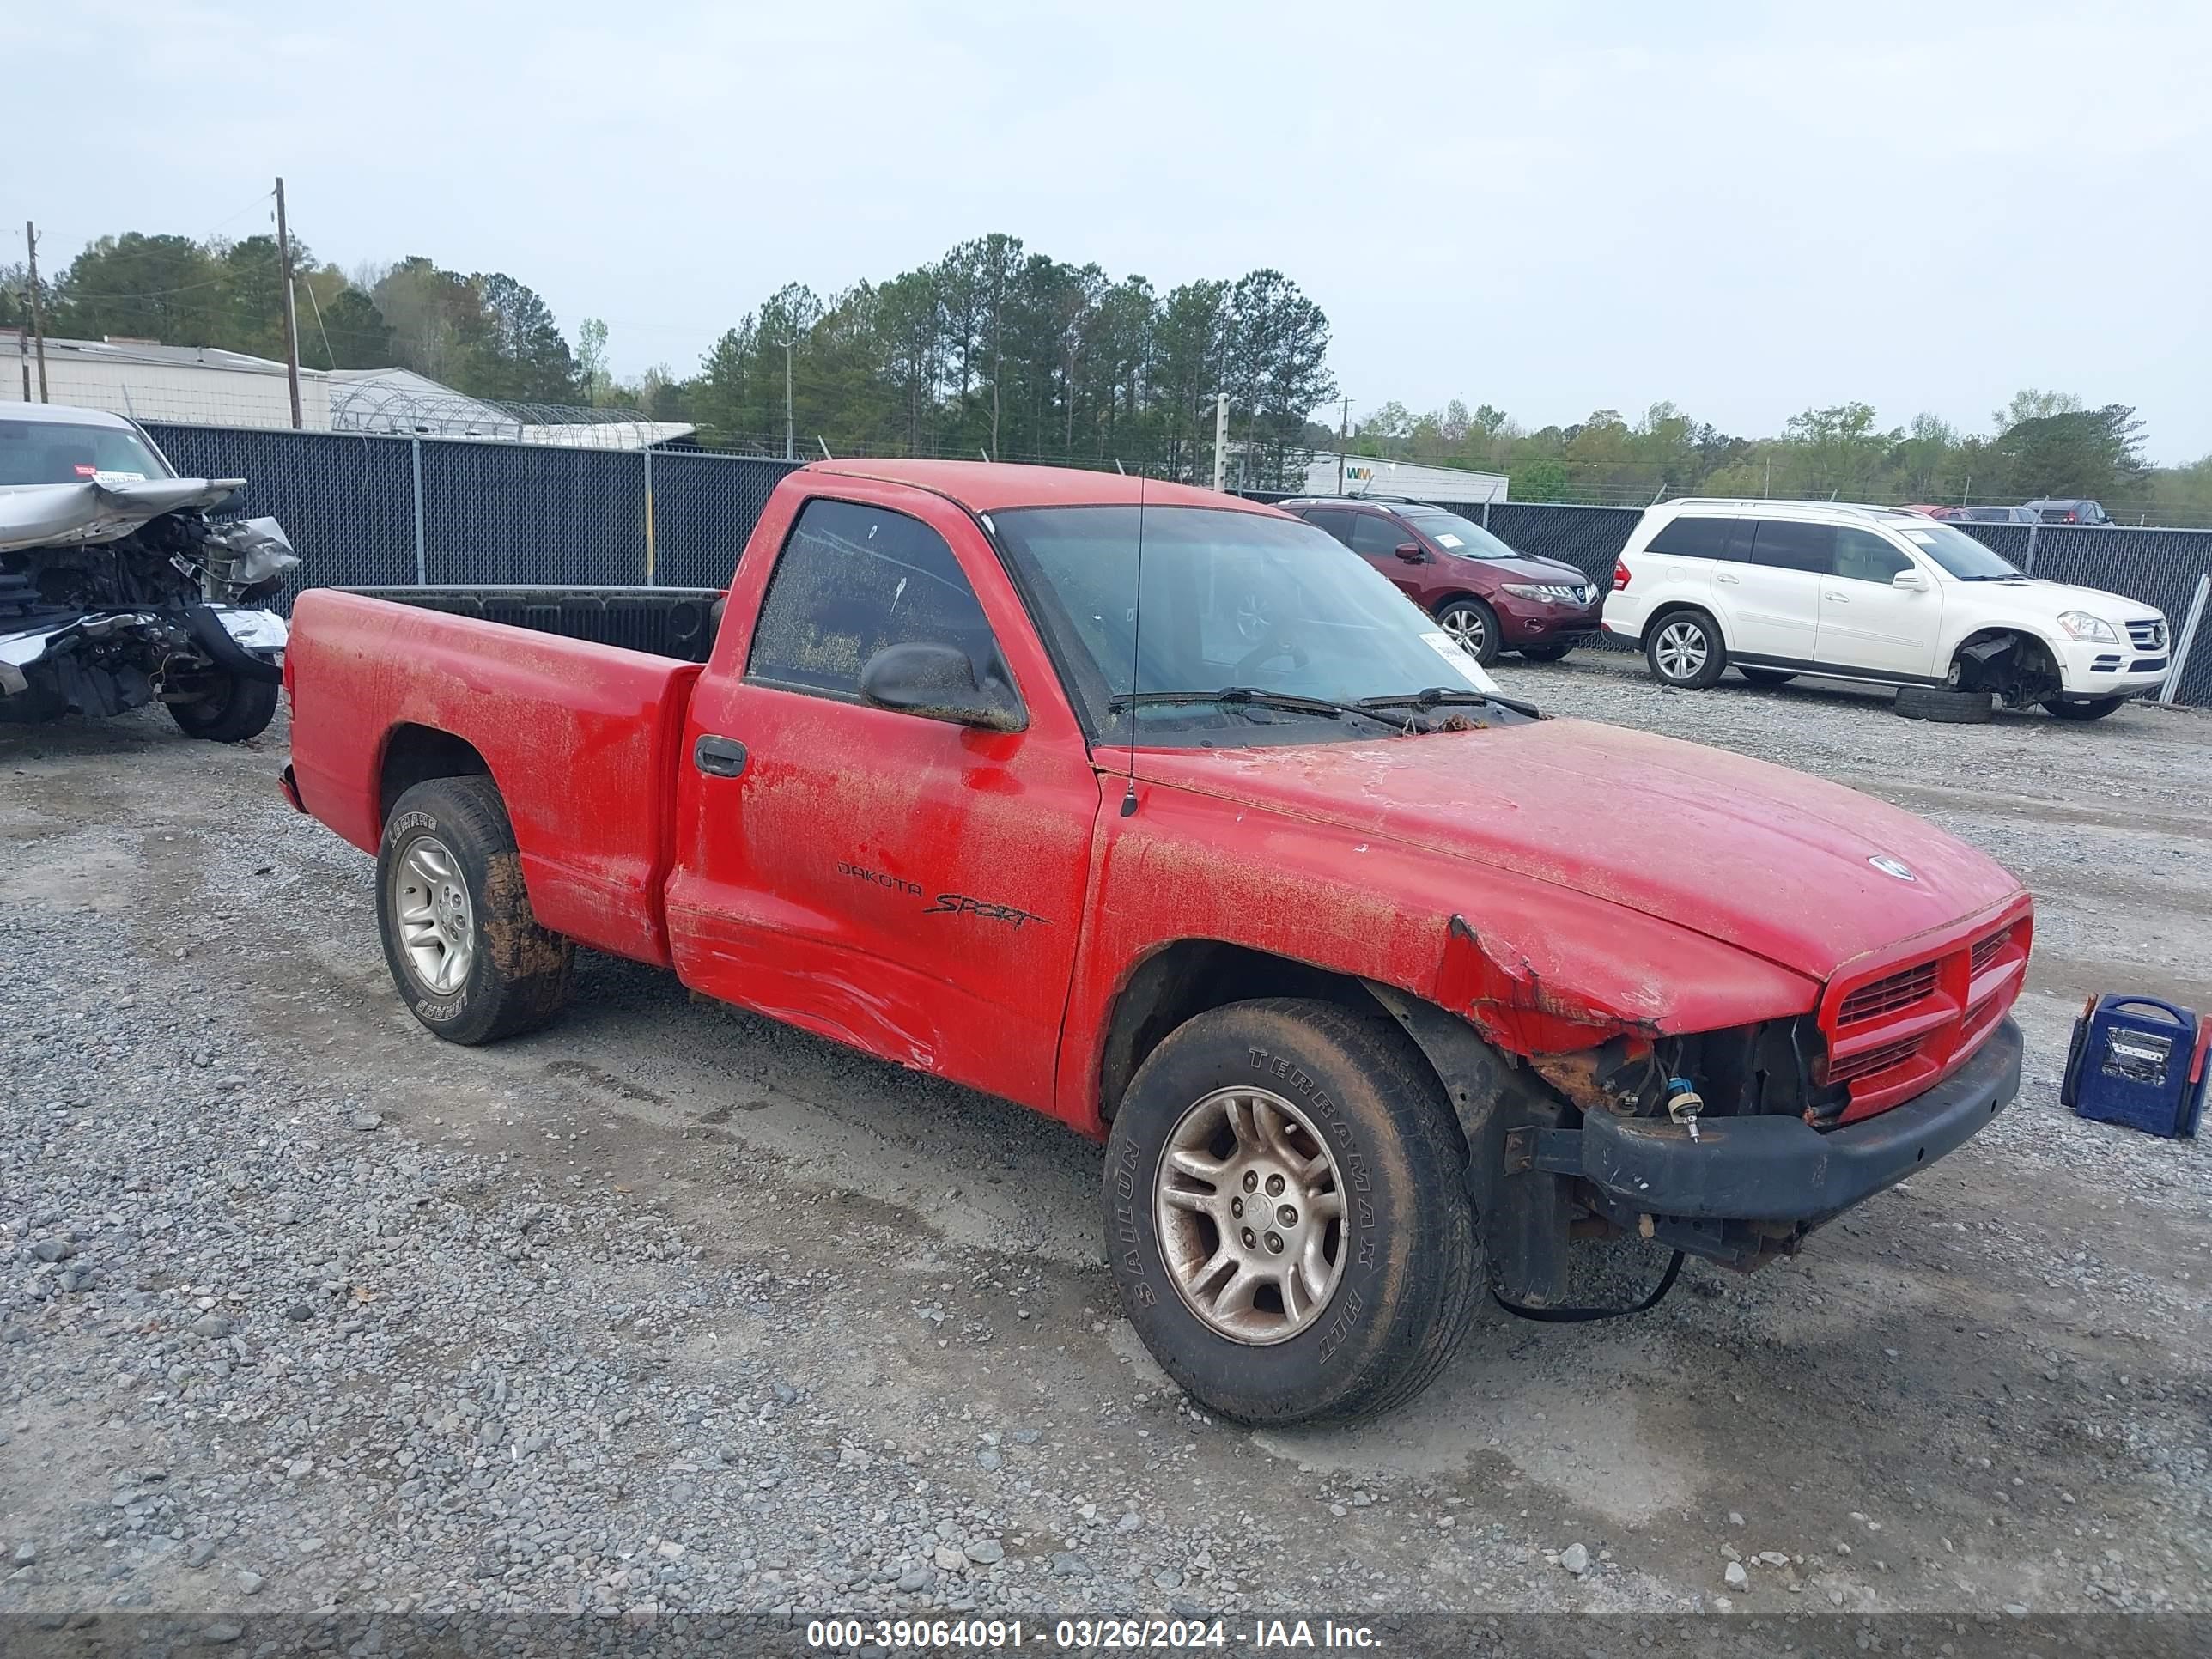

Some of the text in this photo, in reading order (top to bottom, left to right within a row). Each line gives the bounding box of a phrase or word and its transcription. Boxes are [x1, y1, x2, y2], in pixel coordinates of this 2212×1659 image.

[1346, 467, 1371, 480] WM
[837, 861, 1053, 931] DAKOTA SPORT
[1249, 1047, 1375, 1271] TERRAMAX
[1117, 1139, 1158, 1308] SAILUN
